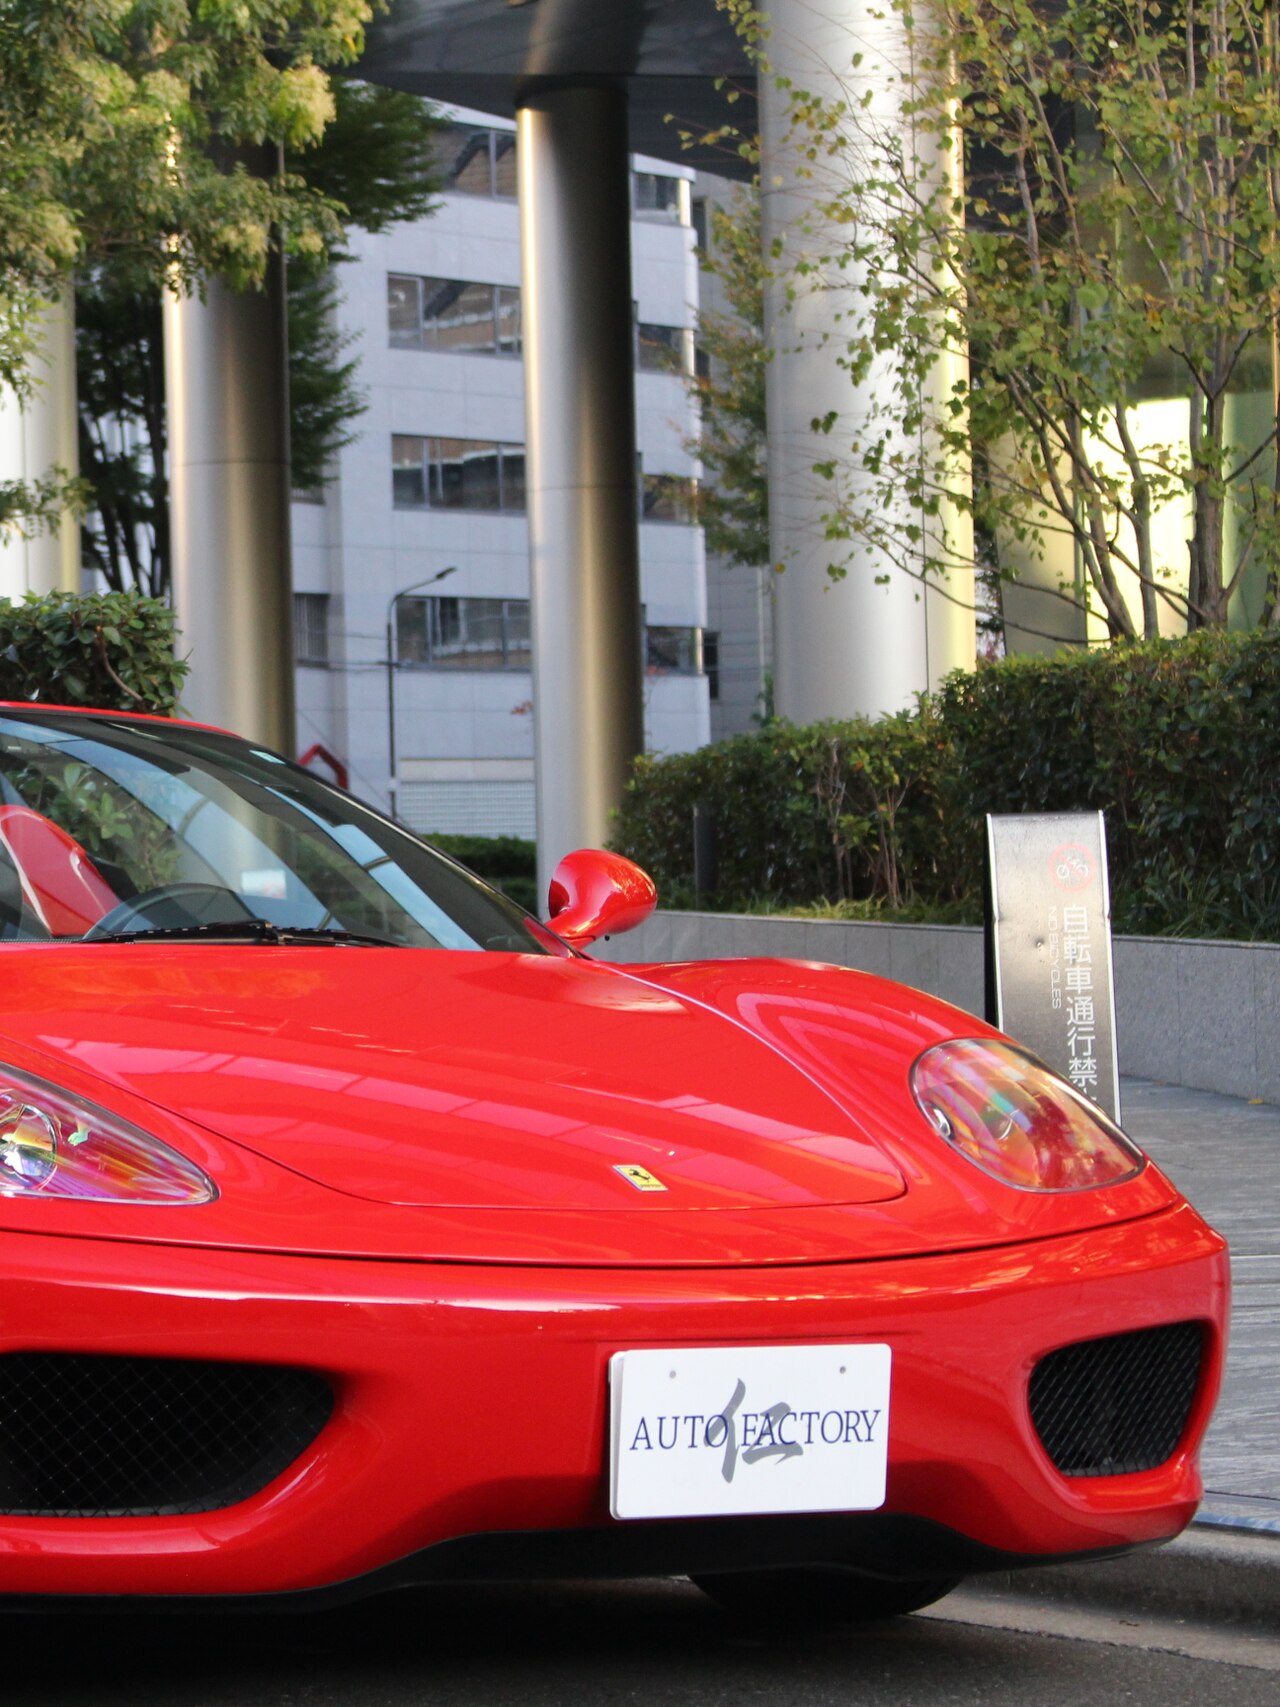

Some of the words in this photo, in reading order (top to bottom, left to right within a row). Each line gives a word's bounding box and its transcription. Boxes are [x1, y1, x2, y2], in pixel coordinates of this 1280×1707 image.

[1048, 906, 1058, 931] NO
[1049, 934, 1061, 1009] BICYCLES
[630, 1414, 729, 1450] AUTO
[740, 1409, 881, 1447] FACTORY
